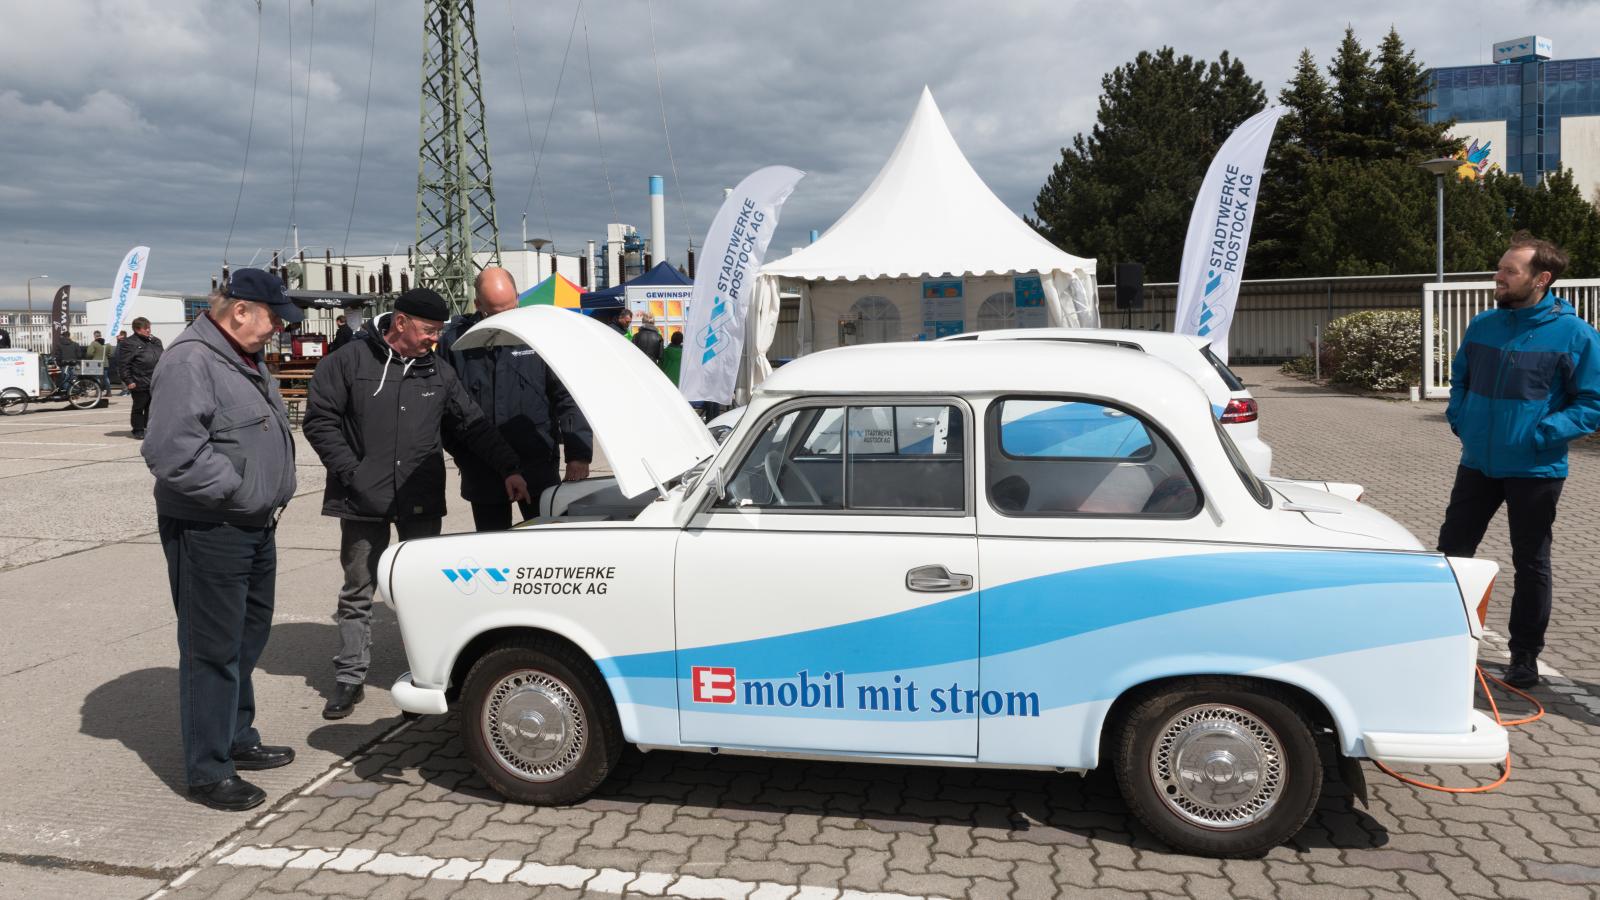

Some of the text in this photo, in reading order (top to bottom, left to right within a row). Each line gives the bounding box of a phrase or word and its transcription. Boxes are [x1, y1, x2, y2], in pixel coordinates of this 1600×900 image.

[717, 197, 755, 292] STADTWERKE
[1210, 164, 1239, 268] STADTWERKE
[1224, 174, 1253, 273] ROSTOCK AG
[729, 210, 765, 300] ROSTOCK AG
[646, 291, 693, 299] GEWINNSPI
[512, 582, 608, 595] ROSTOCK AG
[516, 566, 616, 579] STADTWERKE
[742, 669, 846, 709] mobil
[856, 674, 920, 712] mit
[930, 682, 1040, 717] strom
